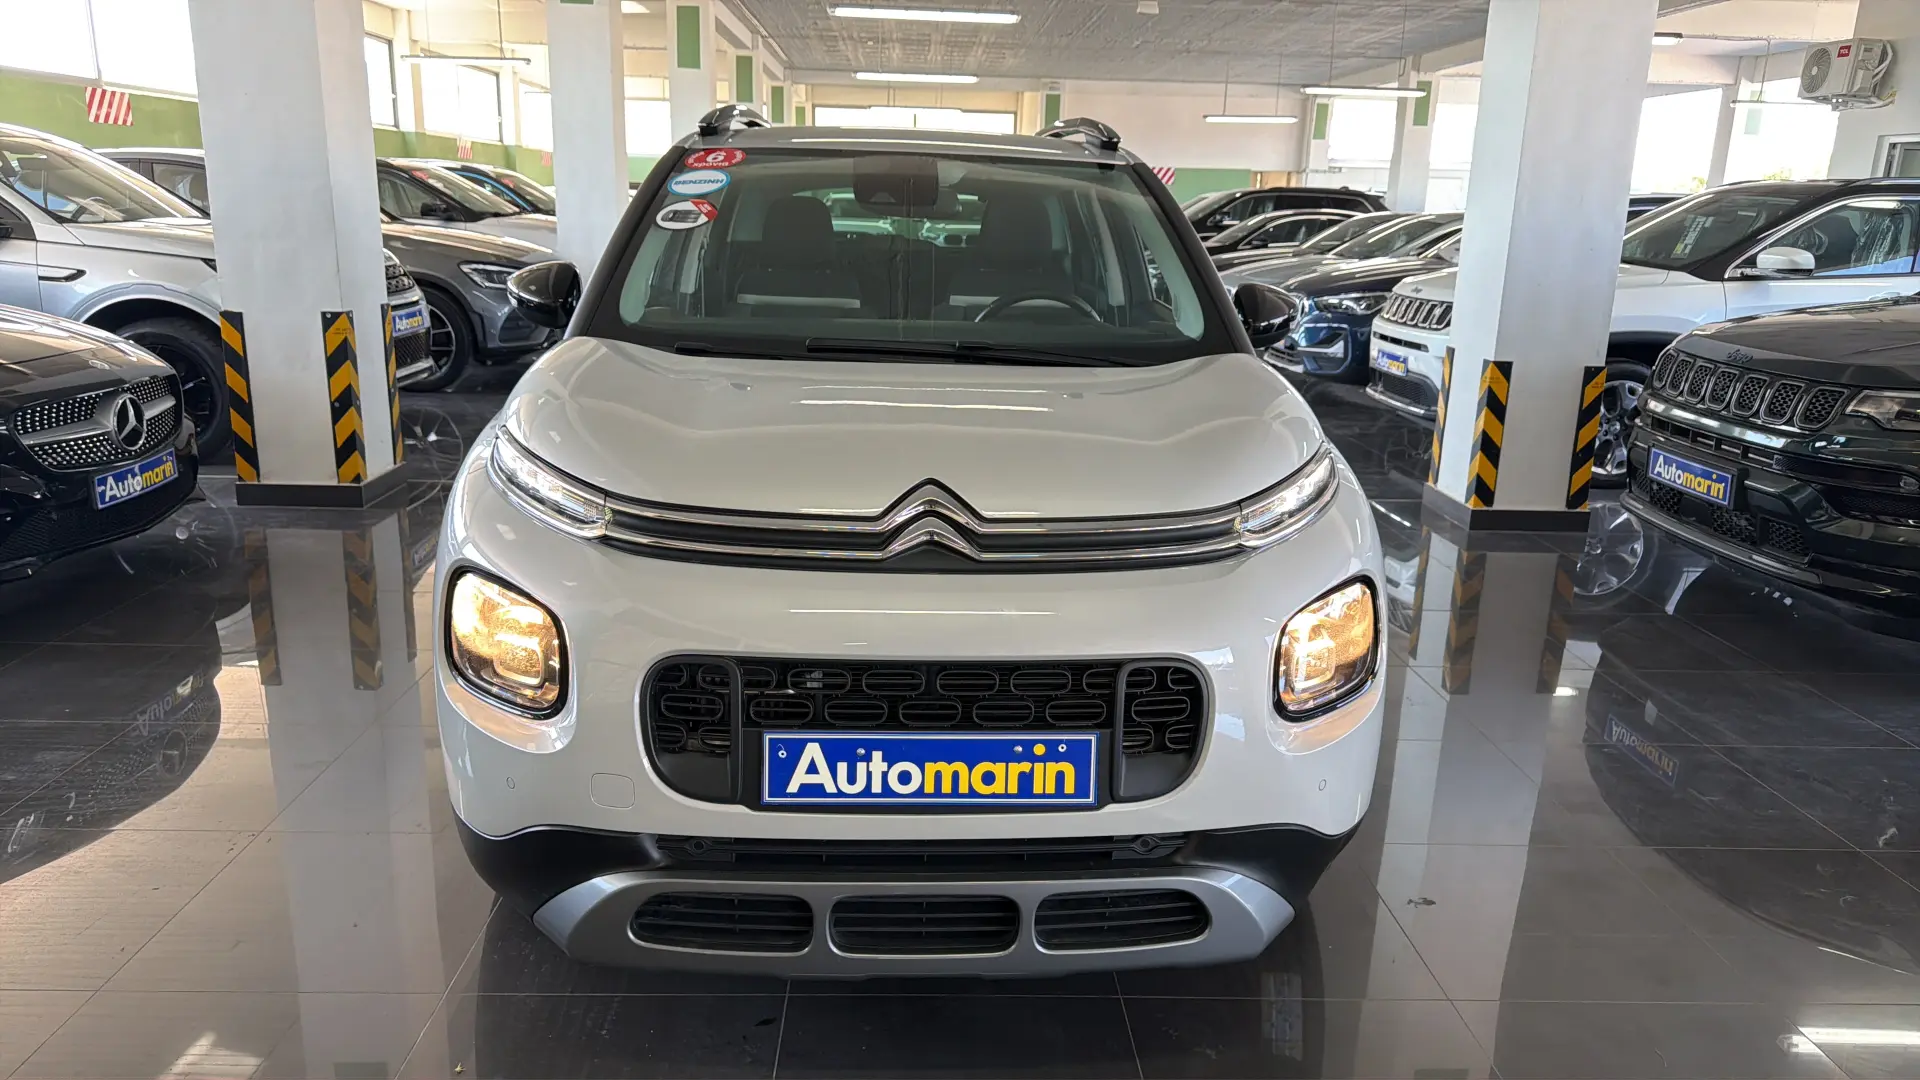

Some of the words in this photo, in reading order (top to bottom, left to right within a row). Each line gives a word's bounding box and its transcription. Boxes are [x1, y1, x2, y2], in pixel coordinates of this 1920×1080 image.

[706, 151, 727, 162] 6
[105, 456, 175, 502] Automarin
[1654, 454, 1726, 500] Automarin
[786, 742, 1077, 796] Automarin
